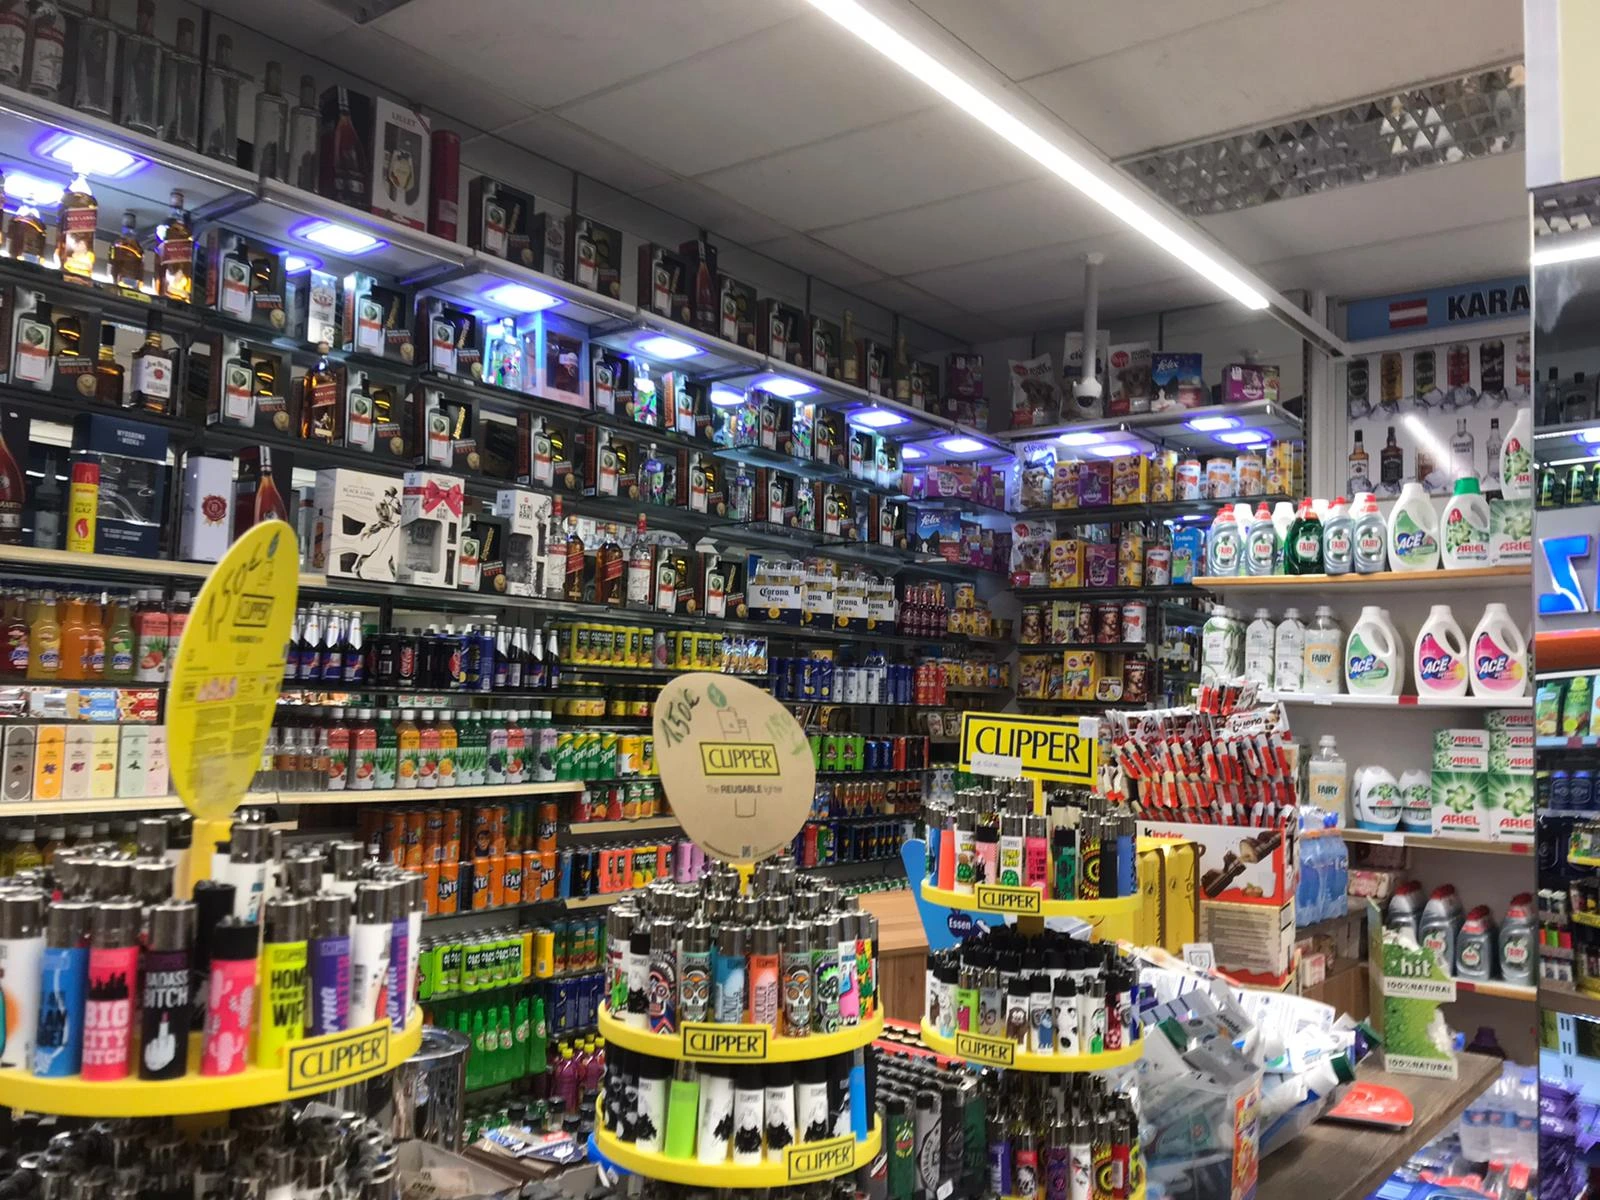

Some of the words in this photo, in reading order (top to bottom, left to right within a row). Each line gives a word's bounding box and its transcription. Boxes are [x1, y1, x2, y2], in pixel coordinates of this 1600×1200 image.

[1299, 542, 1317, 551] FAIRY
[1332, 540, 1347, 549] FAIRY
[1362, 539, 1378, 548] FAIRY
[1399, 534, 1422, 548] ACE
[1499, 542, 1531, 551] ARIE
[1256, 545, 1270, 553] FAIRY
[1456, 544, 1486, 553] ARIEL
[760, 587, 790, 597] Corona
[836, 598, 858, 607] orona
[1311, 654, 1332, 664] FAIRY
[1351, 660, 1374, 674] ACE
[1424, 660, 1449, 674] ACE
[1480, 659, 1506, 674] ACE
[1232, 716, 1263, 732] bueno
[975, 725, 1081, 765] CLIPPER
[1454, 735, 1483, 744] ARIEL
[708, 749, 773, 769] CLIPPER
[1452, 756, 1481, 765] ARIEL
[721, 785, 762, 793] REUSABLE
[1317, 784, 1338, 795] FAIRY
[1441, 815, 1480, 825] ARIEL
[983, 893, 1035, 908] CLIPPER
[948, 918, 971, 930] Essen
[1400, 959, 1432, 977] hit
[271, 969, 304, 989] HOM
[85, 1000, 129, 1026] BIG
[274, 1001, 305, 1027] WIF
[690, 1033, 760, 1053] CLIPPER
[960, 1039, 1009, 1060] CLIPPER
[300, 1037, 382, 1079] CLIPPER
[795, 1148, 851, 1171] CLIPPER
